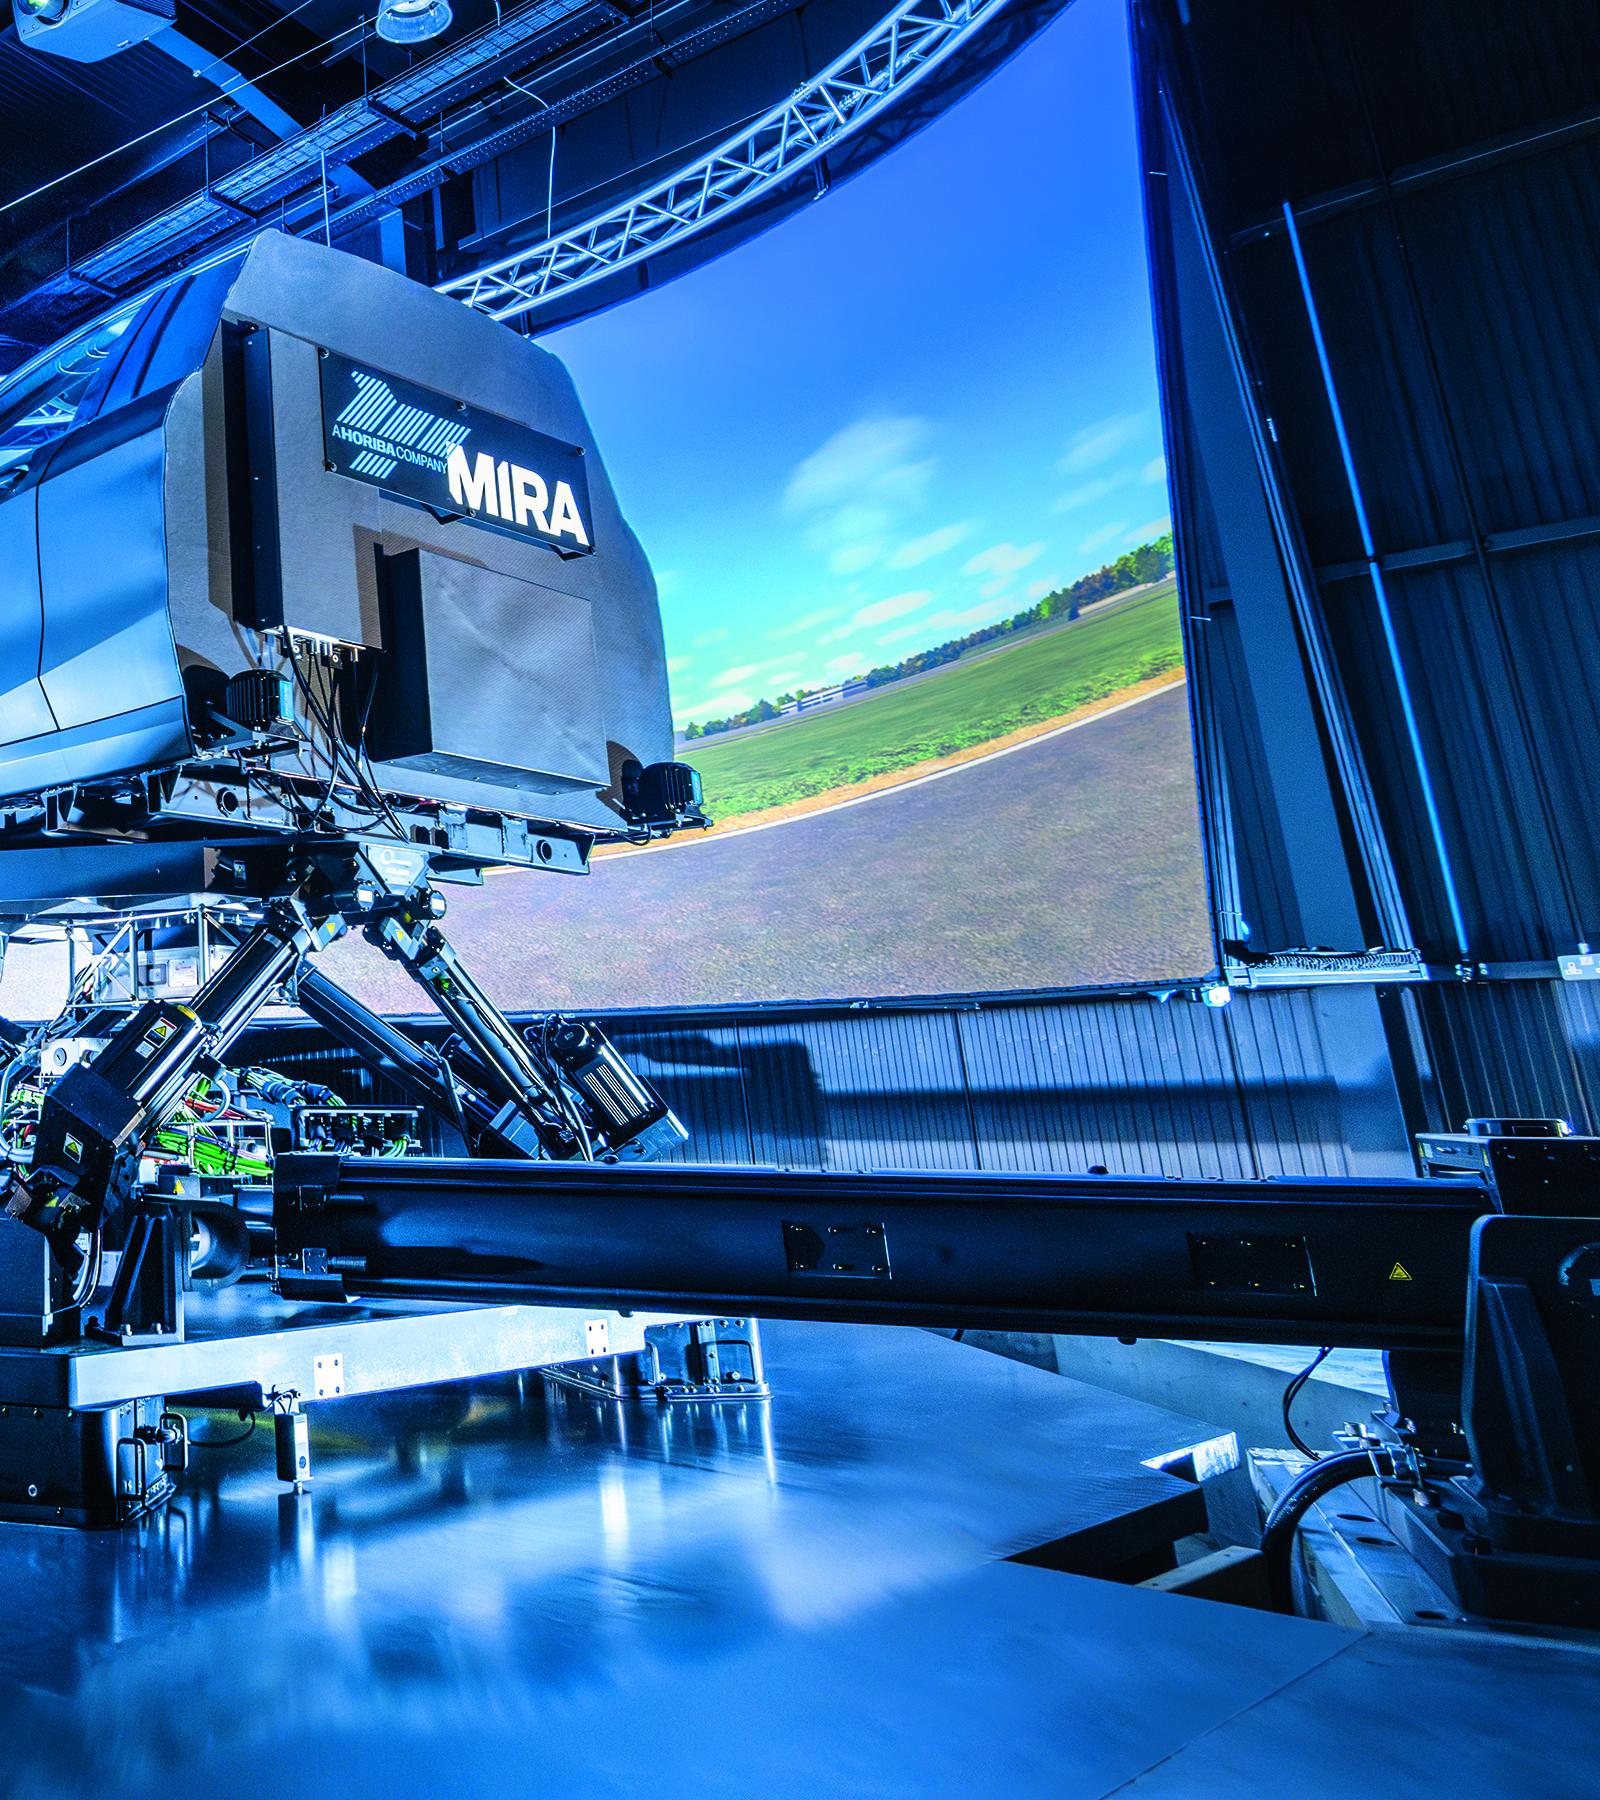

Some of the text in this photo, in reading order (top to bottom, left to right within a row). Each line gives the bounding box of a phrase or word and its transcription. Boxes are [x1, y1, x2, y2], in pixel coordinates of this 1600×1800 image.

[341, 427, 396, 457] HORIBA
[396, 446, 448, 474] COMPANY
[446, 441, 590, 546] MIRA
